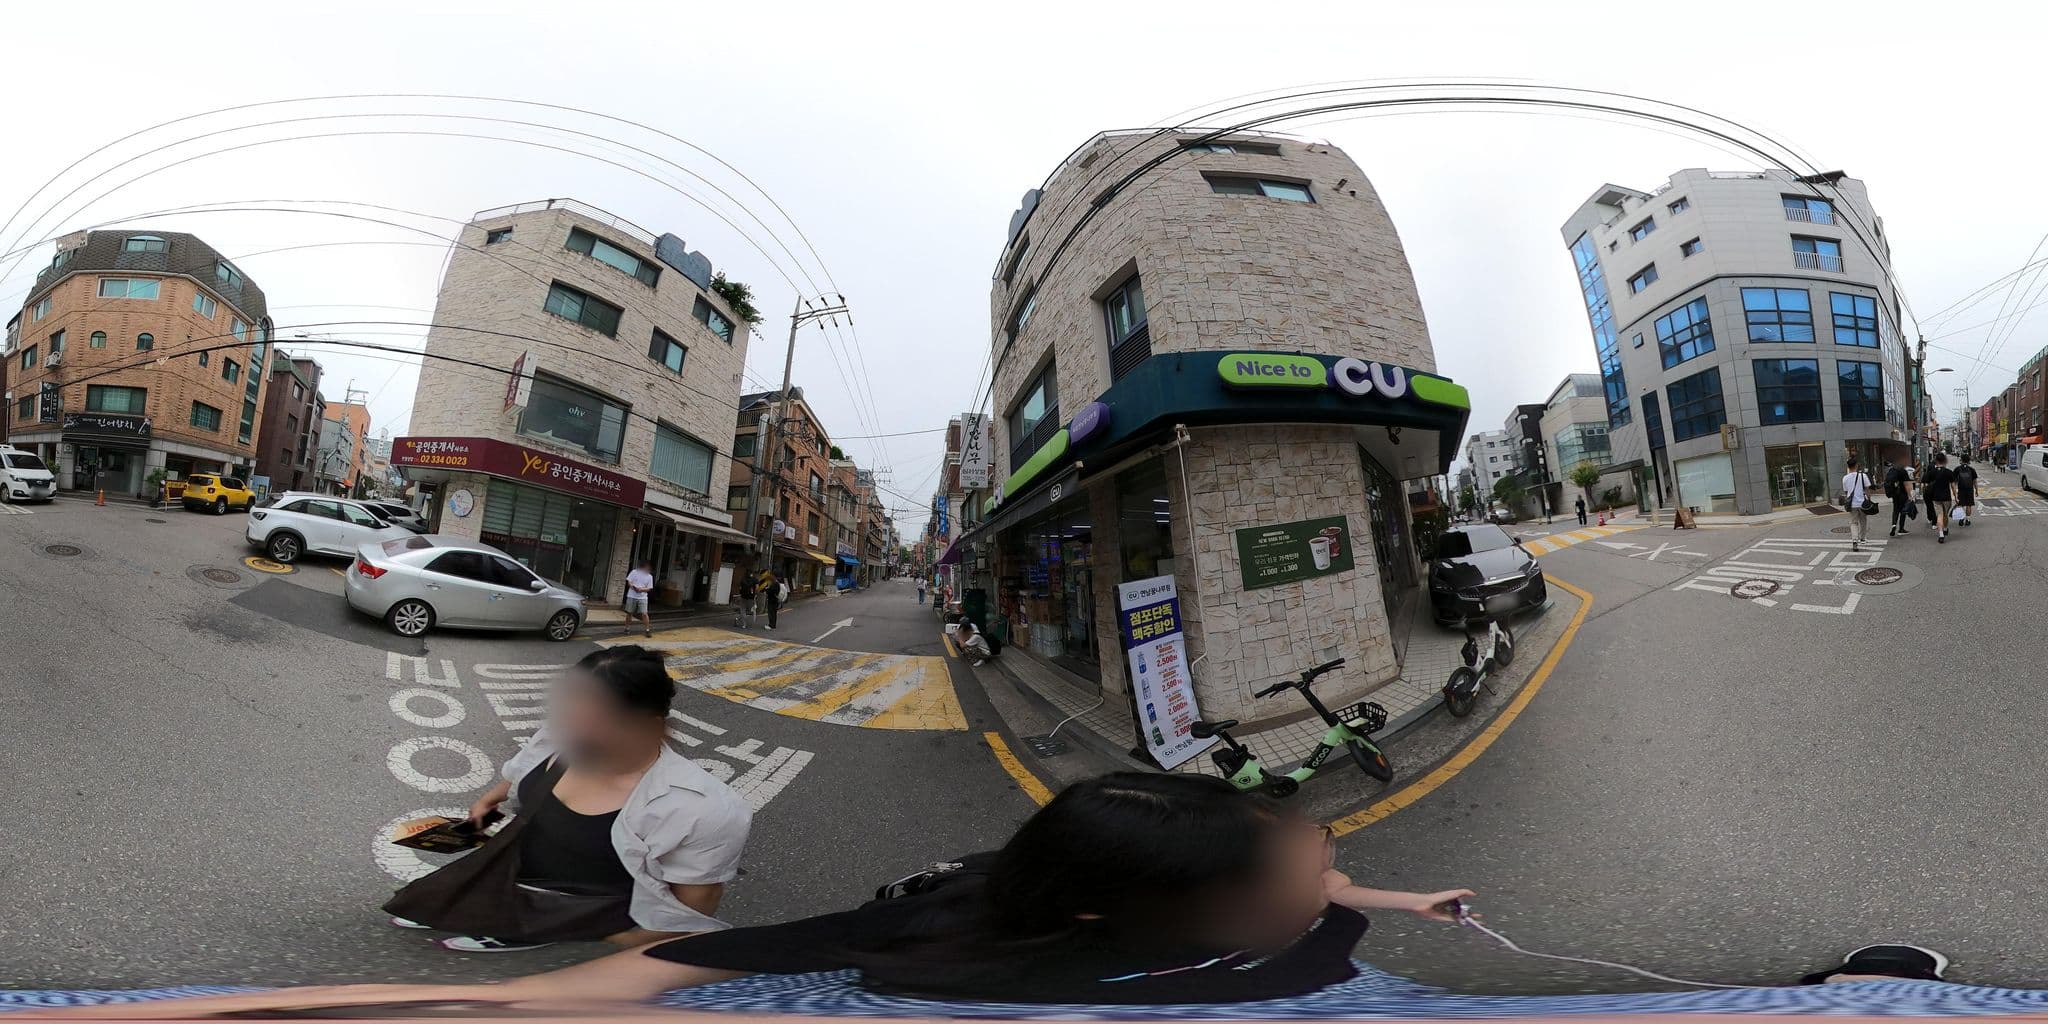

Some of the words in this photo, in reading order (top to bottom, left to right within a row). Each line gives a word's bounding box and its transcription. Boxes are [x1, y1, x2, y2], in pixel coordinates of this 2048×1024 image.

[1235, 360, 1286, 377] Nice
[1290, 363, 1312, 378] to
[1333, 357, 1407, 399] CU
[420, 454, 431, 464] 02
[431, 455, 445, 465] 334
[445, 456, 468, 466] 0023
[1129, 603, 1173, 627] 점포단독
[1131, 617, 1176, 640] 맥주할인
